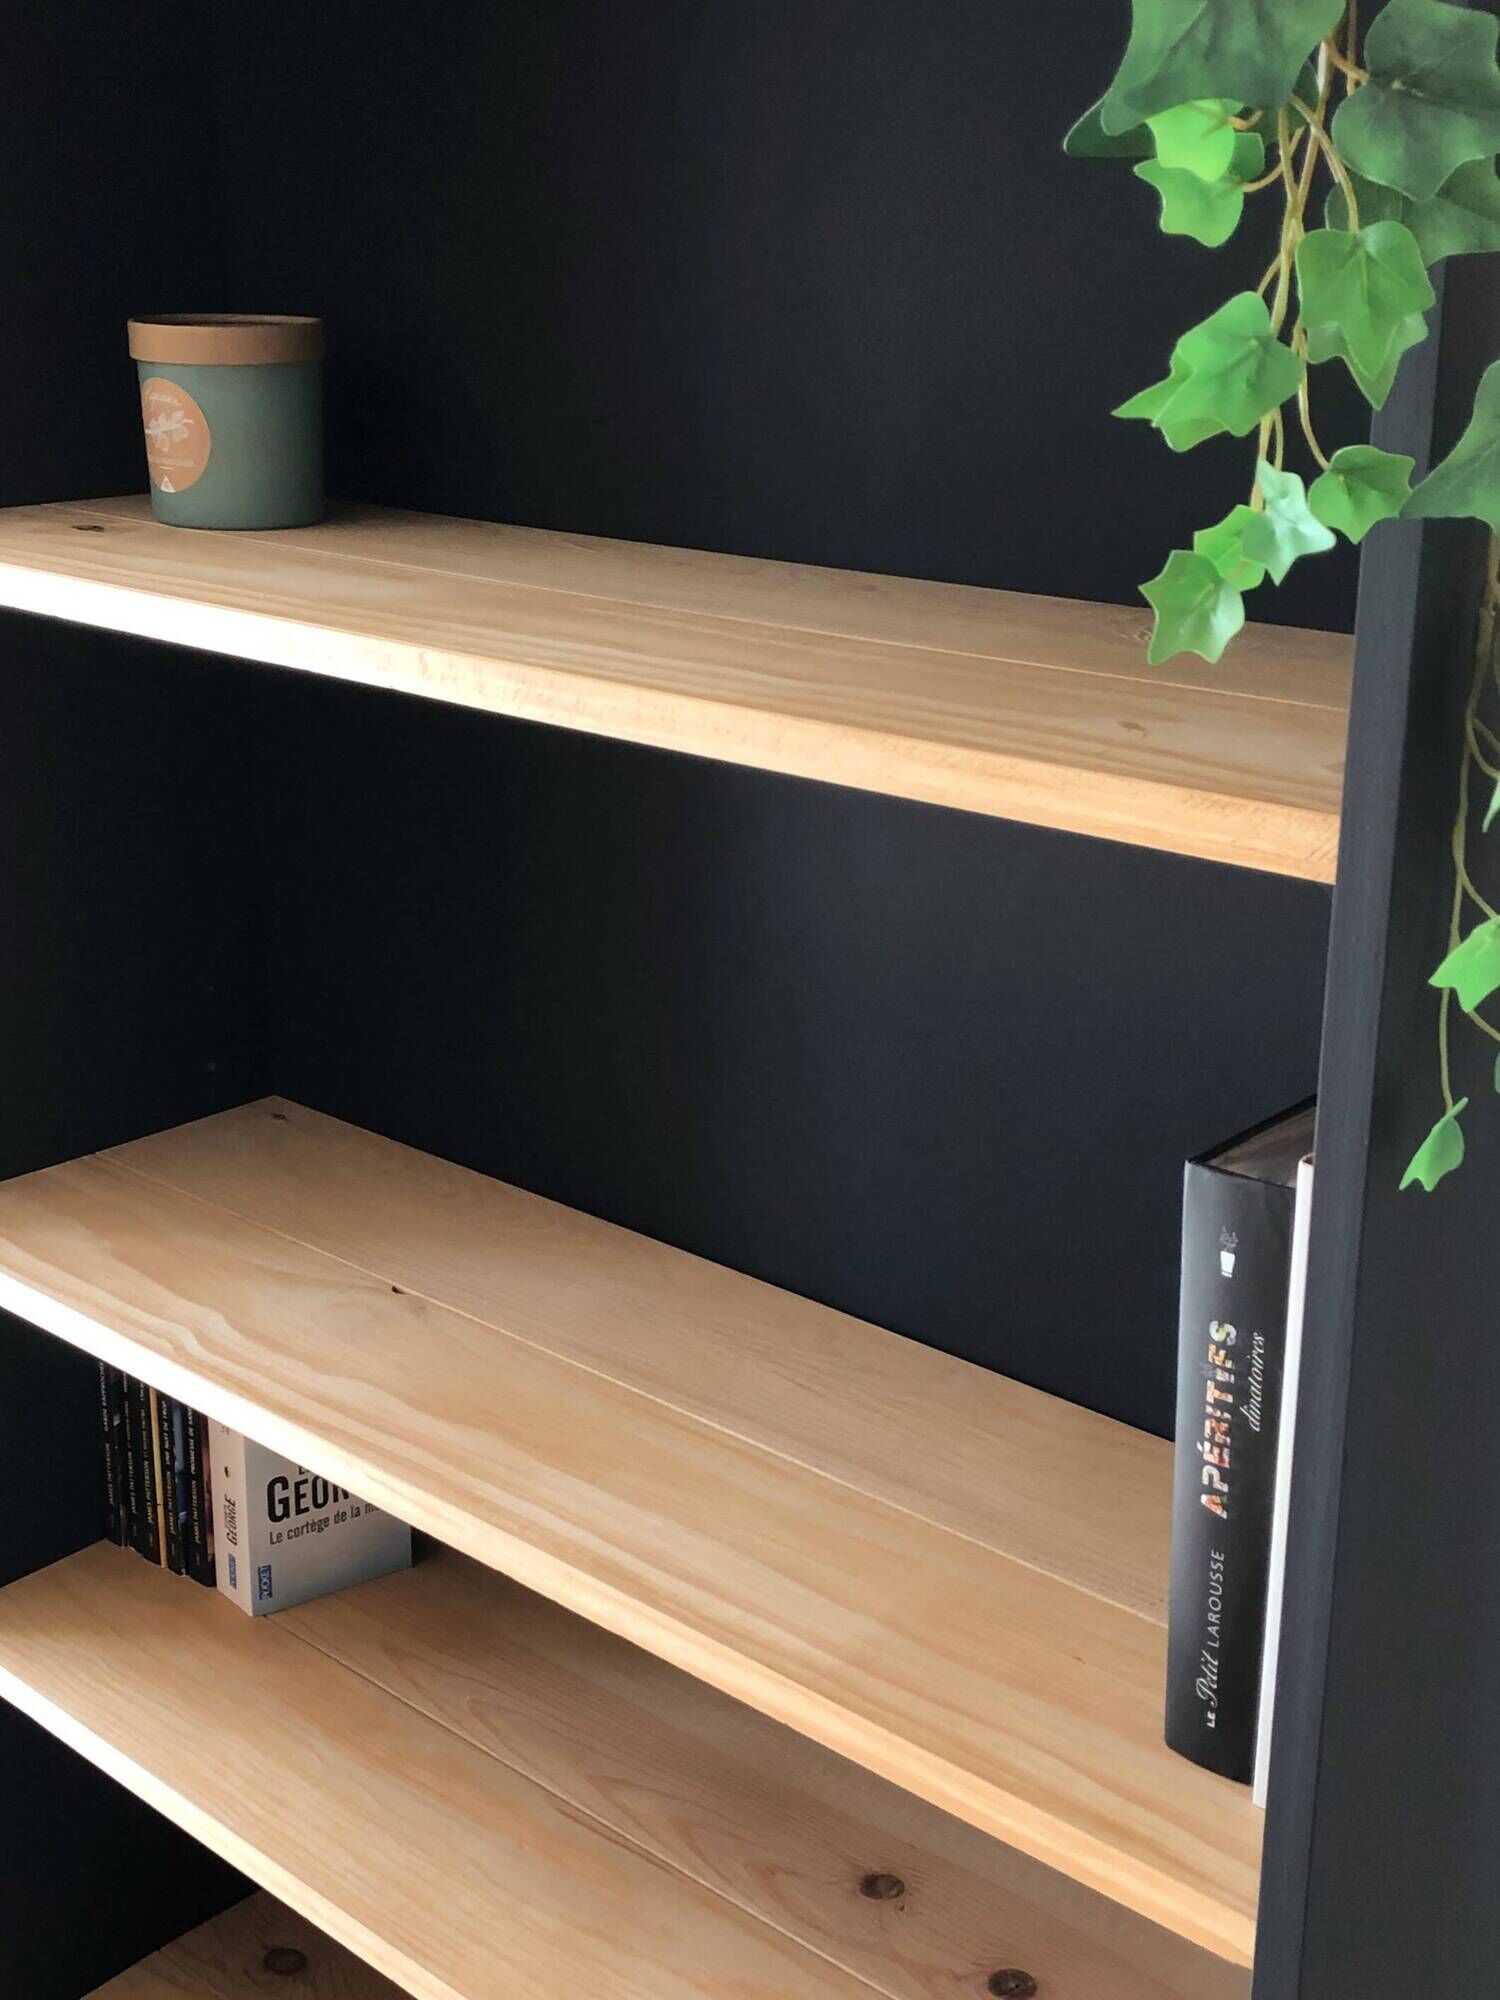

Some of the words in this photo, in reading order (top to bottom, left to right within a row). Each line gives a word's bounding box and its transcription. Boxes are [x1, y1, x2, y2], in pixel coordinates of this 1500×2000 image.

[1197, 1319, 1237, 1520] APÉRITIFS
[143, 1460, 151, 1501] PATTERSON
[224, 1494, 238, 1546] GEORGE
[269, 1531, 284, 1545] Le
[286, 1516, 331, 1541] cortège
[333, 1510, 348, 1525] de
[350, 1504, 361, 1518] la
[1207, 1550, 1225, 1649] LAROUSSE
[1195, 1650, 1220, 1708] Petit
[1205, 1711, 1216, 1729] LE
